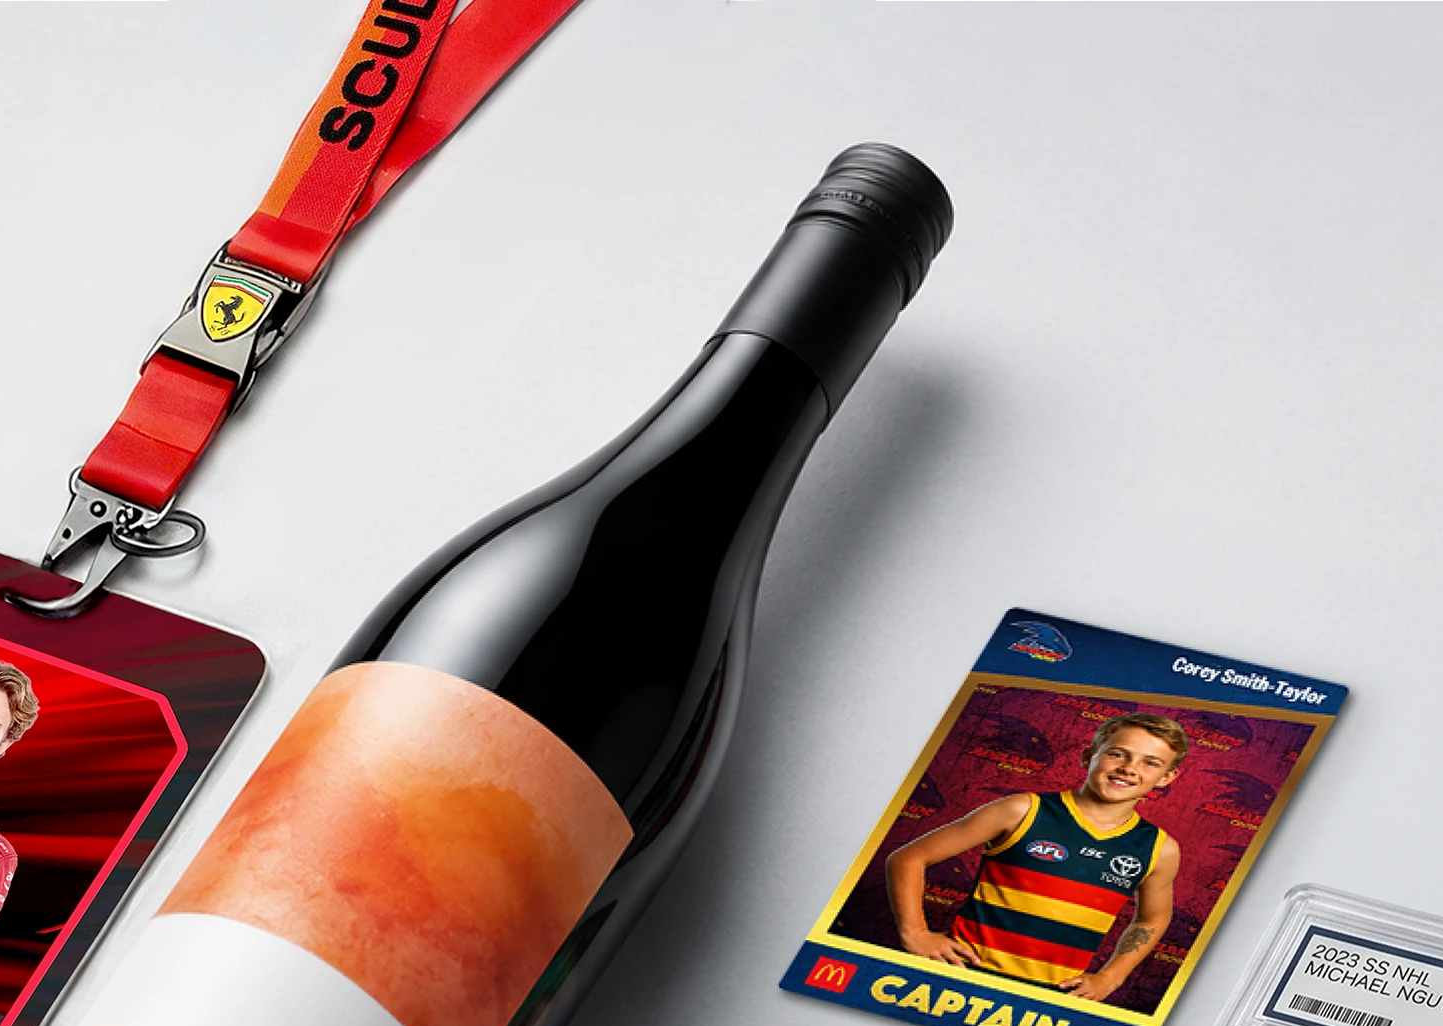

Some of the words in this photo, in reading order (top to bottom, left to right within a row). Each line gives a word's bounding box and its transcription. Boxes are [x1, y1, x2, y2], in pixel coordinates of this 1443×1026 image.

[1172, 656, 1221, 682] Corey
[1221, 668, 1328, 704] Smith-Taylor
[1304, 961, 1391, 997] MICHAEL
[1311, 944, 1361, 968] 2023
[1362, 957, 1391, 976] SS
[1391, 965, 1431, 988] NHL
